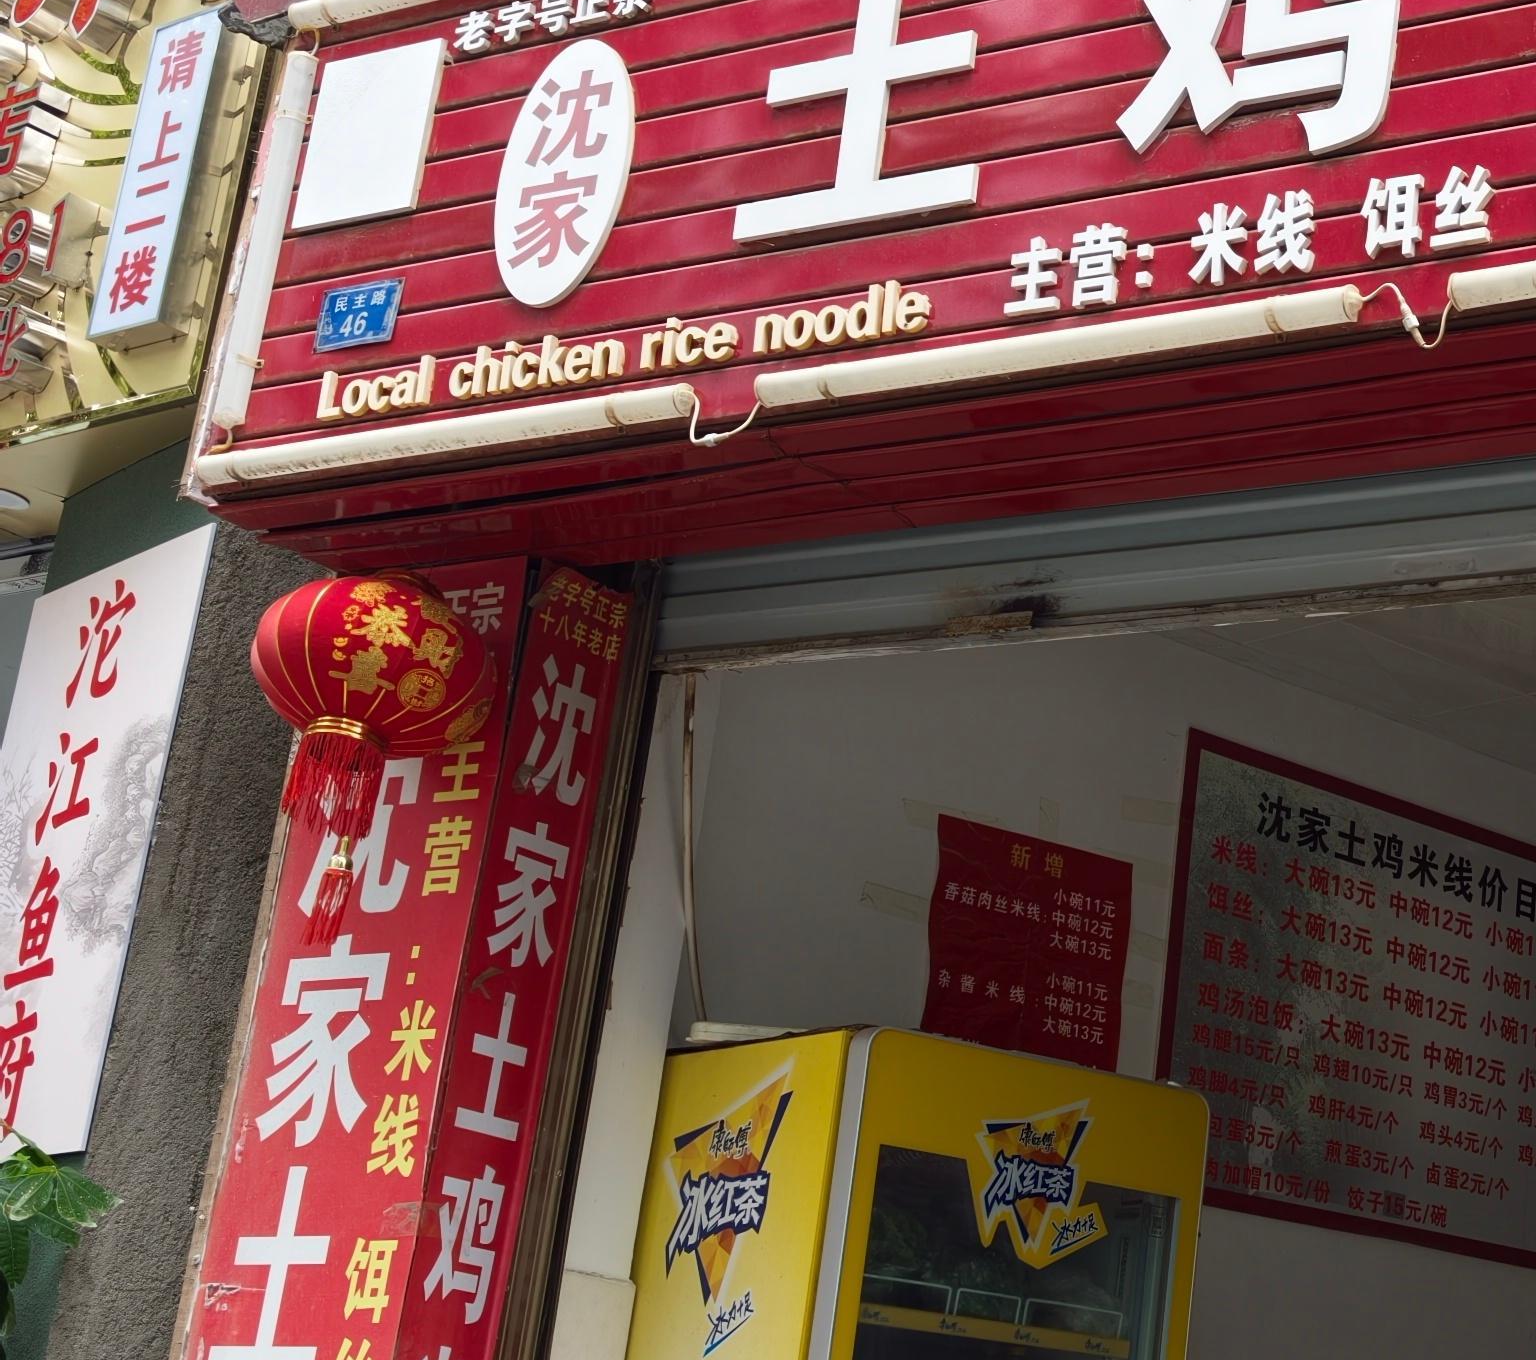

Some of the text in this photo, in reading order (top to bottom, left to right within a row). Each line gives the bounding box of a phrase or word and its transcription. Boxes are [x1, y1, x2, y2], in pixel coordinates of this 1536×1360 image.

[108, 29, 207, 315] 请上二楼
[508, 69, 611, 272] 沈家
[1361, 164, 1498, 260] 饵丝
[334, 290, 387, 313] 民主路
[339, 311, 369, 338] 46
[316, 280, 931, 422] Local chicken rice noodle
[549, 575, 629, 629] 老字号正宗
[539, 607, 622, 663] 十八年老店
[1010, 843, 1065, 879] 新增
[1051, 910, 1113, 939] 中碗12元
[1054, 888, 1116, 919] 小碗11元
[1389, 890, 1474, 940] 中碗12元
[1049, 931, 1112, 961] 大碗13元
[1386, 936, 1470, 985] 中碗12元
[1043, 994, 1107, 1024] 中碗12元
[1046, 971, 1108, 1003] 小碗11元
[1383, 982, 1468, 1031] 中碗12元
[1041, 1015, 1104, 1046] 大碗13元
[1312, 1053, 1414, 1098] 鸡翅10元/只
[1423, 1081, 1508, 1121] 鸡胃3元/个
[1423, 1041, 1506, 1088] 中碗12元
[1308, 1094, 1399, 1135] 鸡肝4元/个
[1419, 1121, 1504, 1159] 鸡头4元/个
[988, 1154, 1071, 1208] 冰红茶
[1426, 1162, 1510, 1201] 卤蛋2元/个
[669, 1175, 768, 1257] 冰红茶
